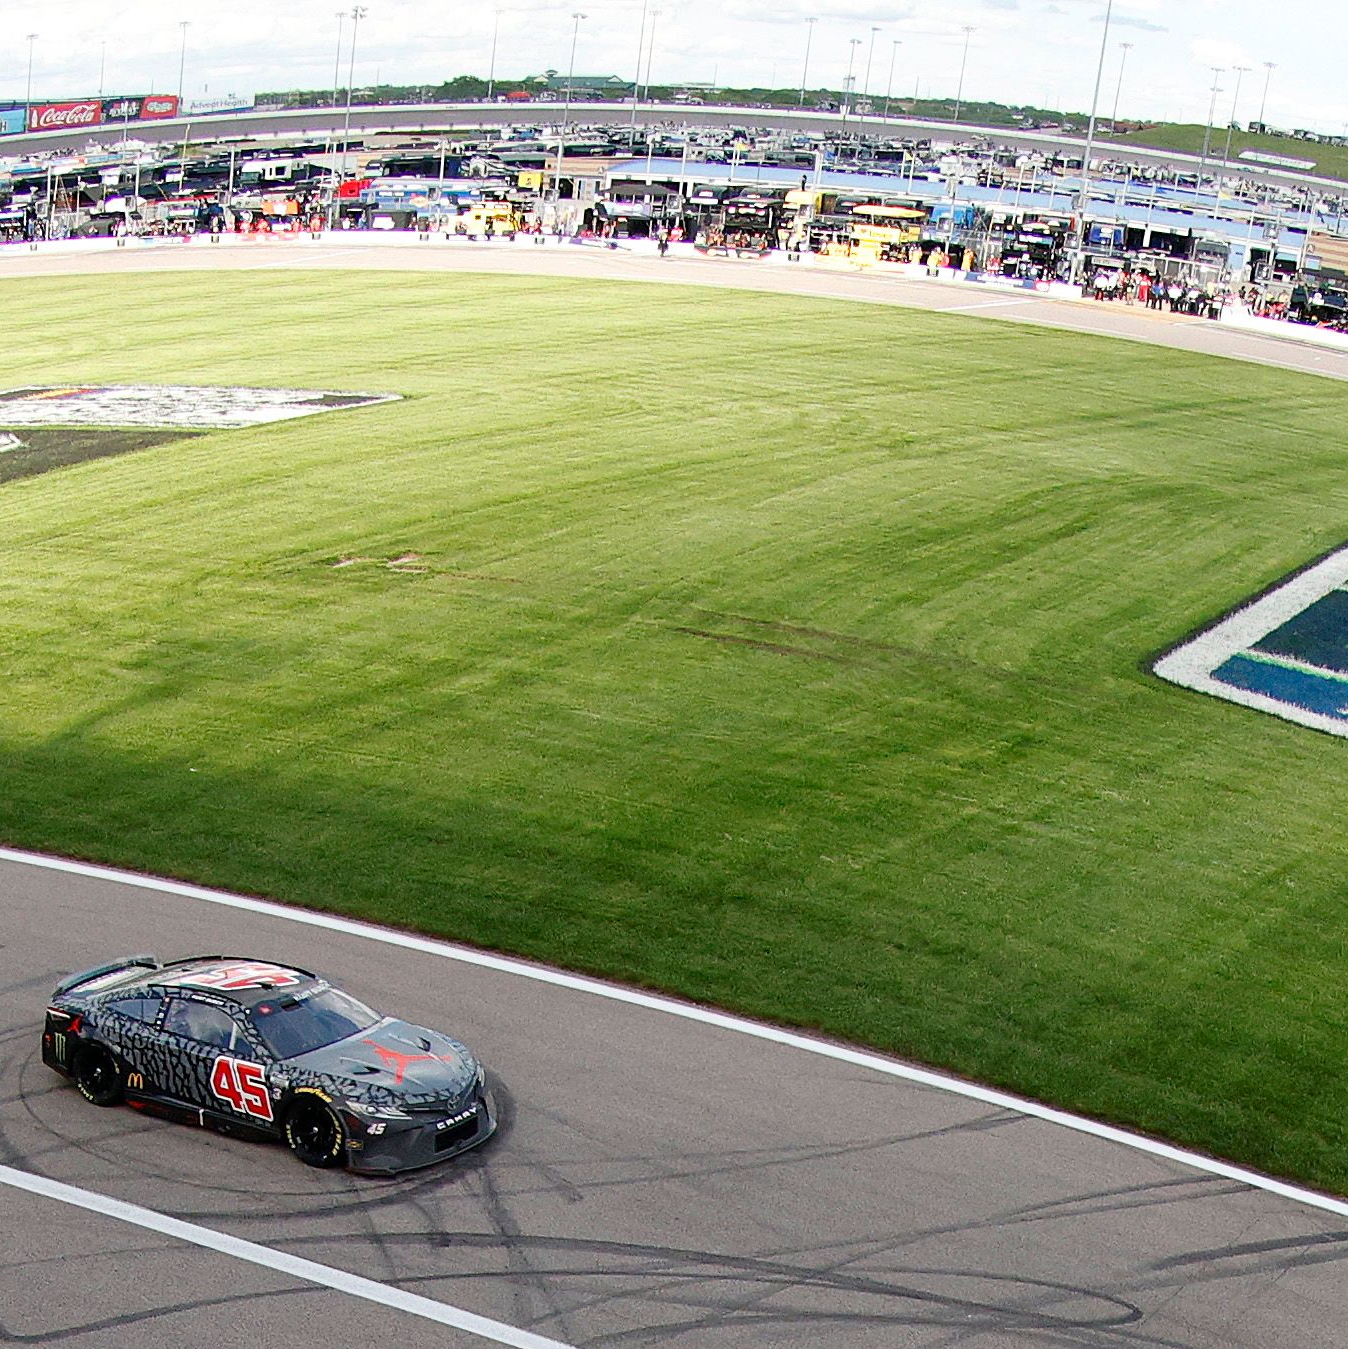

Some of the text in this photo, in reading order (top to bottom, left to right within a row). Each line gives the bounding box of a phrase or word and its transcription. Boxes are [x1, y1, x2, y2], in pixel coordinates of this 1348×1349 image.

[39, 102, 98, 127] Coca-Cola
[210, 1055, 274, 1121] 45
[366, 1122, 387, 1135] 45
[436, 1106, 478, 1130] CAMRY
